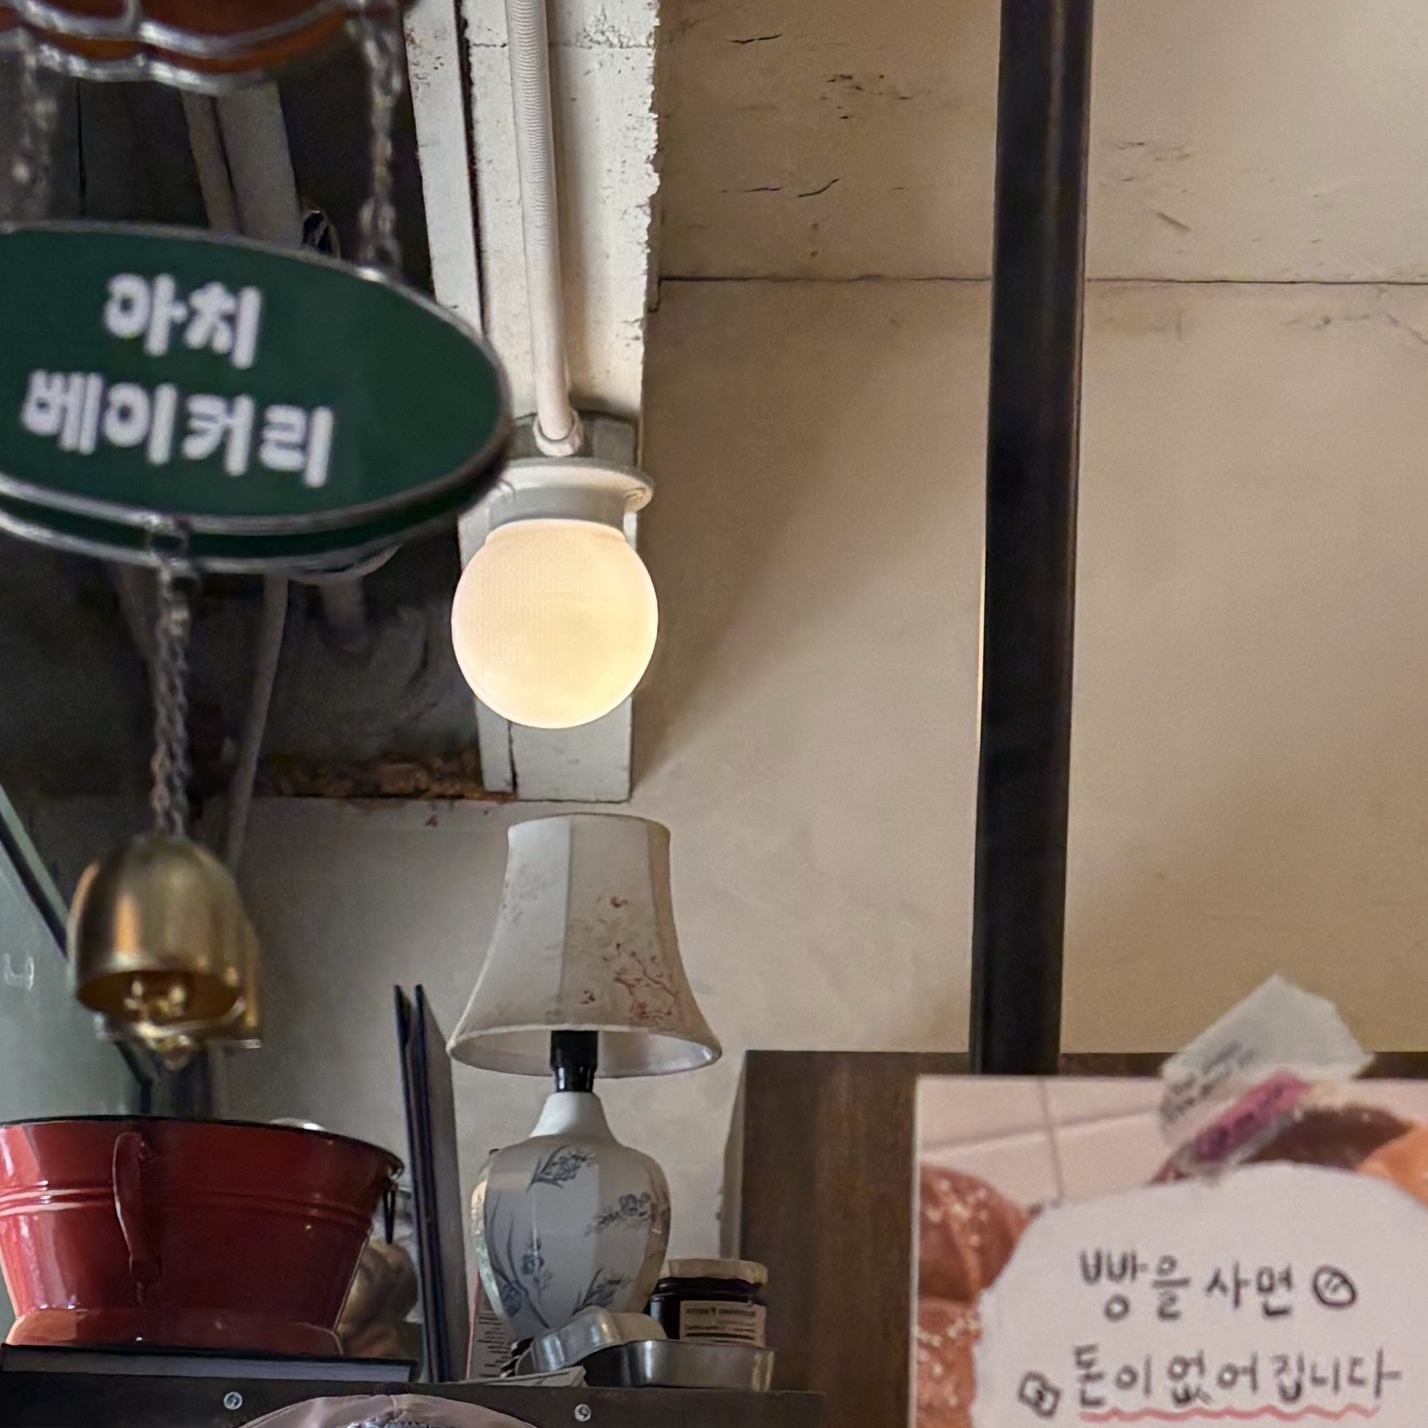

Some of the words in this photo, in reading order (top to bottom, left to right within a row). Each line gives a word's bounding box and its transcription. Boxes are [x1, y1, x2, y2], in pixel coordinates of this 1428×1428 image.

[104, 273, 261, 369] 아치
[22, 369, 335, 488] 베이커리
[1080, 1249, 1191, 1321] 빵을
[1204, 1259, 1295, 1318] 사면
